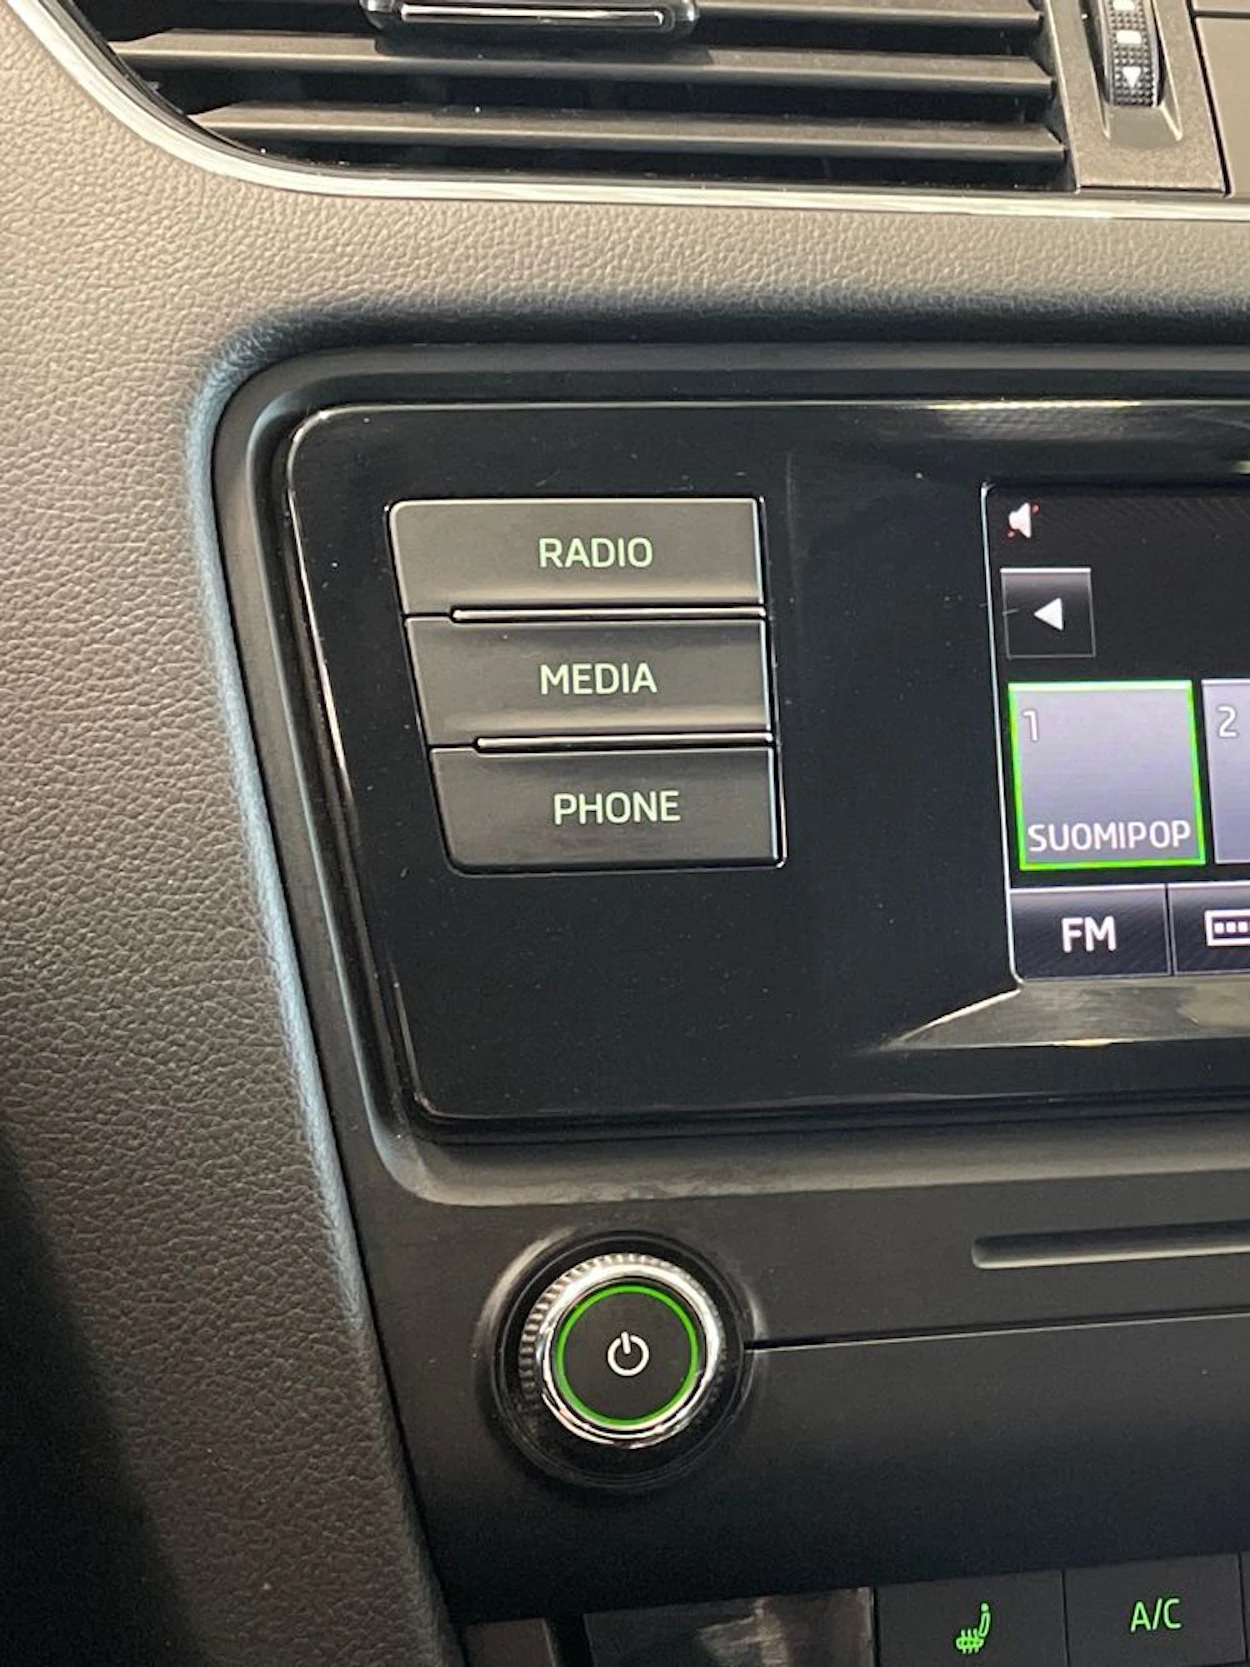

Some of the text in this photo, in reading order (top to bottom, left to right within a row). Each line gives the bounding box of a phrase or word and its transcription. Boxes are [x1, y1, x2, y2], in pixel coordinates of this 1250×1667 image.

[538, 537, 654, 568] RADIO
[540, 662, 658, 695] MEDIA
[1023, 709, 1039, 742] 1
[1216, 705, 1238, 739] 2
[553, 790, 681, 825] PHONE
[1027, 819, 1192, 853] SUOMIPOP
[1061, 914, 1117, 953] FM
[1129, 1597, 1182, 1633] A/C
